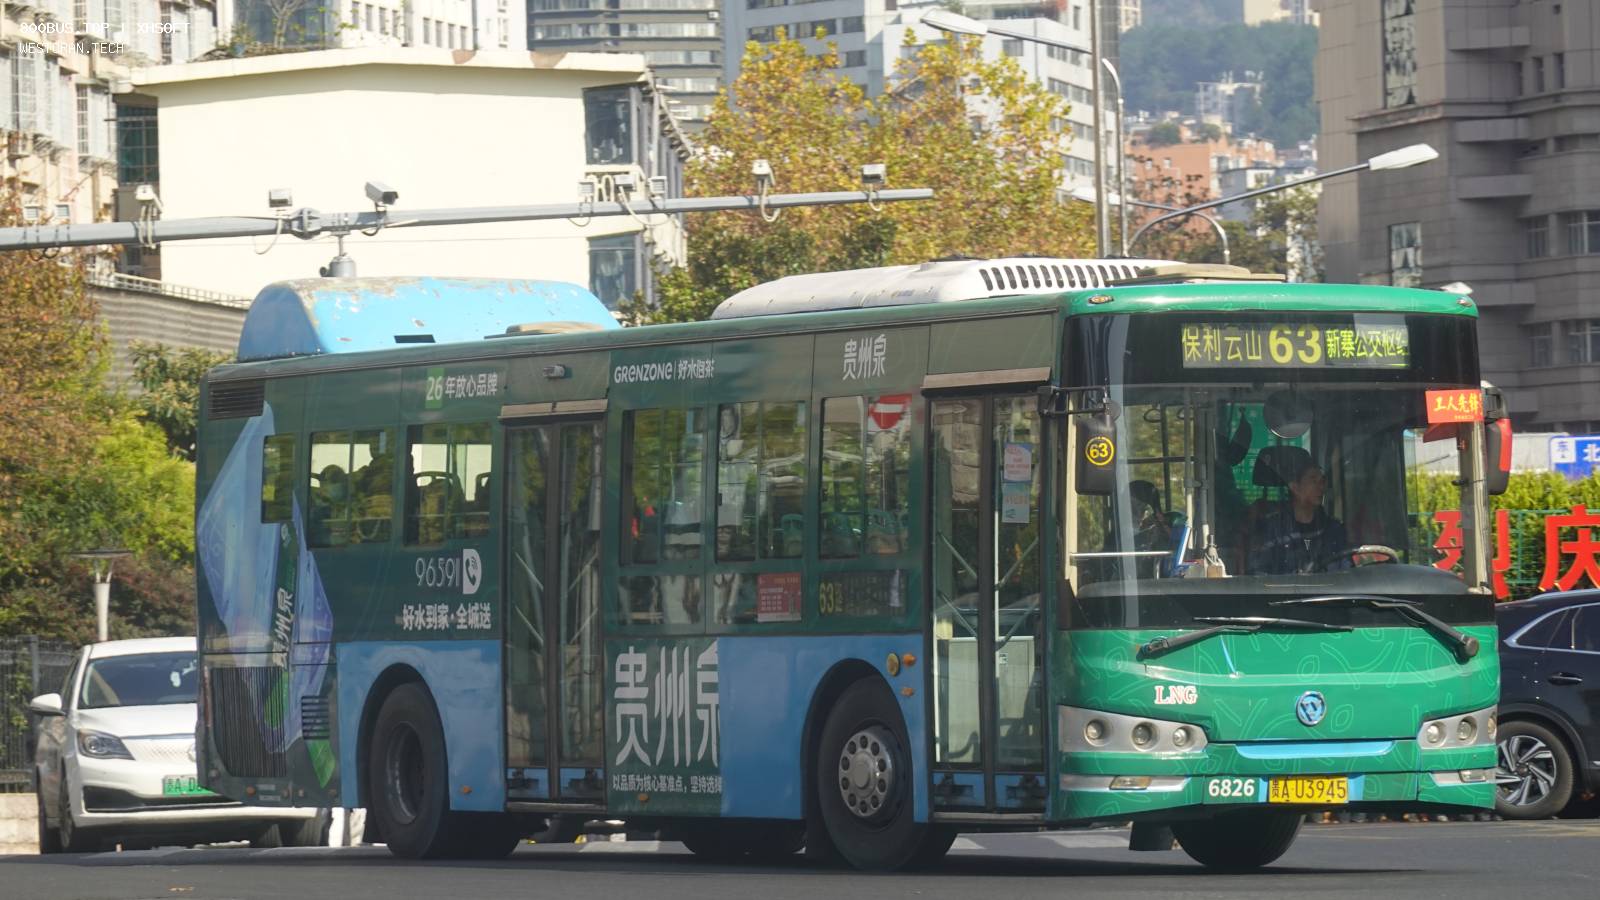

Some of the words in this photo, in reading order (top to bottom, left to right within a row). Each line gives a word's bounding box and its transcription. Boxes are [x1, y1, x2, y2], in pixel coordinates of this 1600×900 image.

[842, 334, 887, 381] 贵州泉
[1182, 325, 1263, 361] 保利云山
[1268, 323, 1323, 364] 63
[426, 376, 444, 401] 26
[445, 372, 498, 399] 年放心品牌
[1433, 392, 1483, 415] 工人先锋
[1089, 442, 1109, 459] 63
[819, 582, 834, 614] 63
[614, 637, 720, 768] 贵州泉
[1154, 685, 1198, 705] LNG
[1208, 779, 1255, 797] 6826
